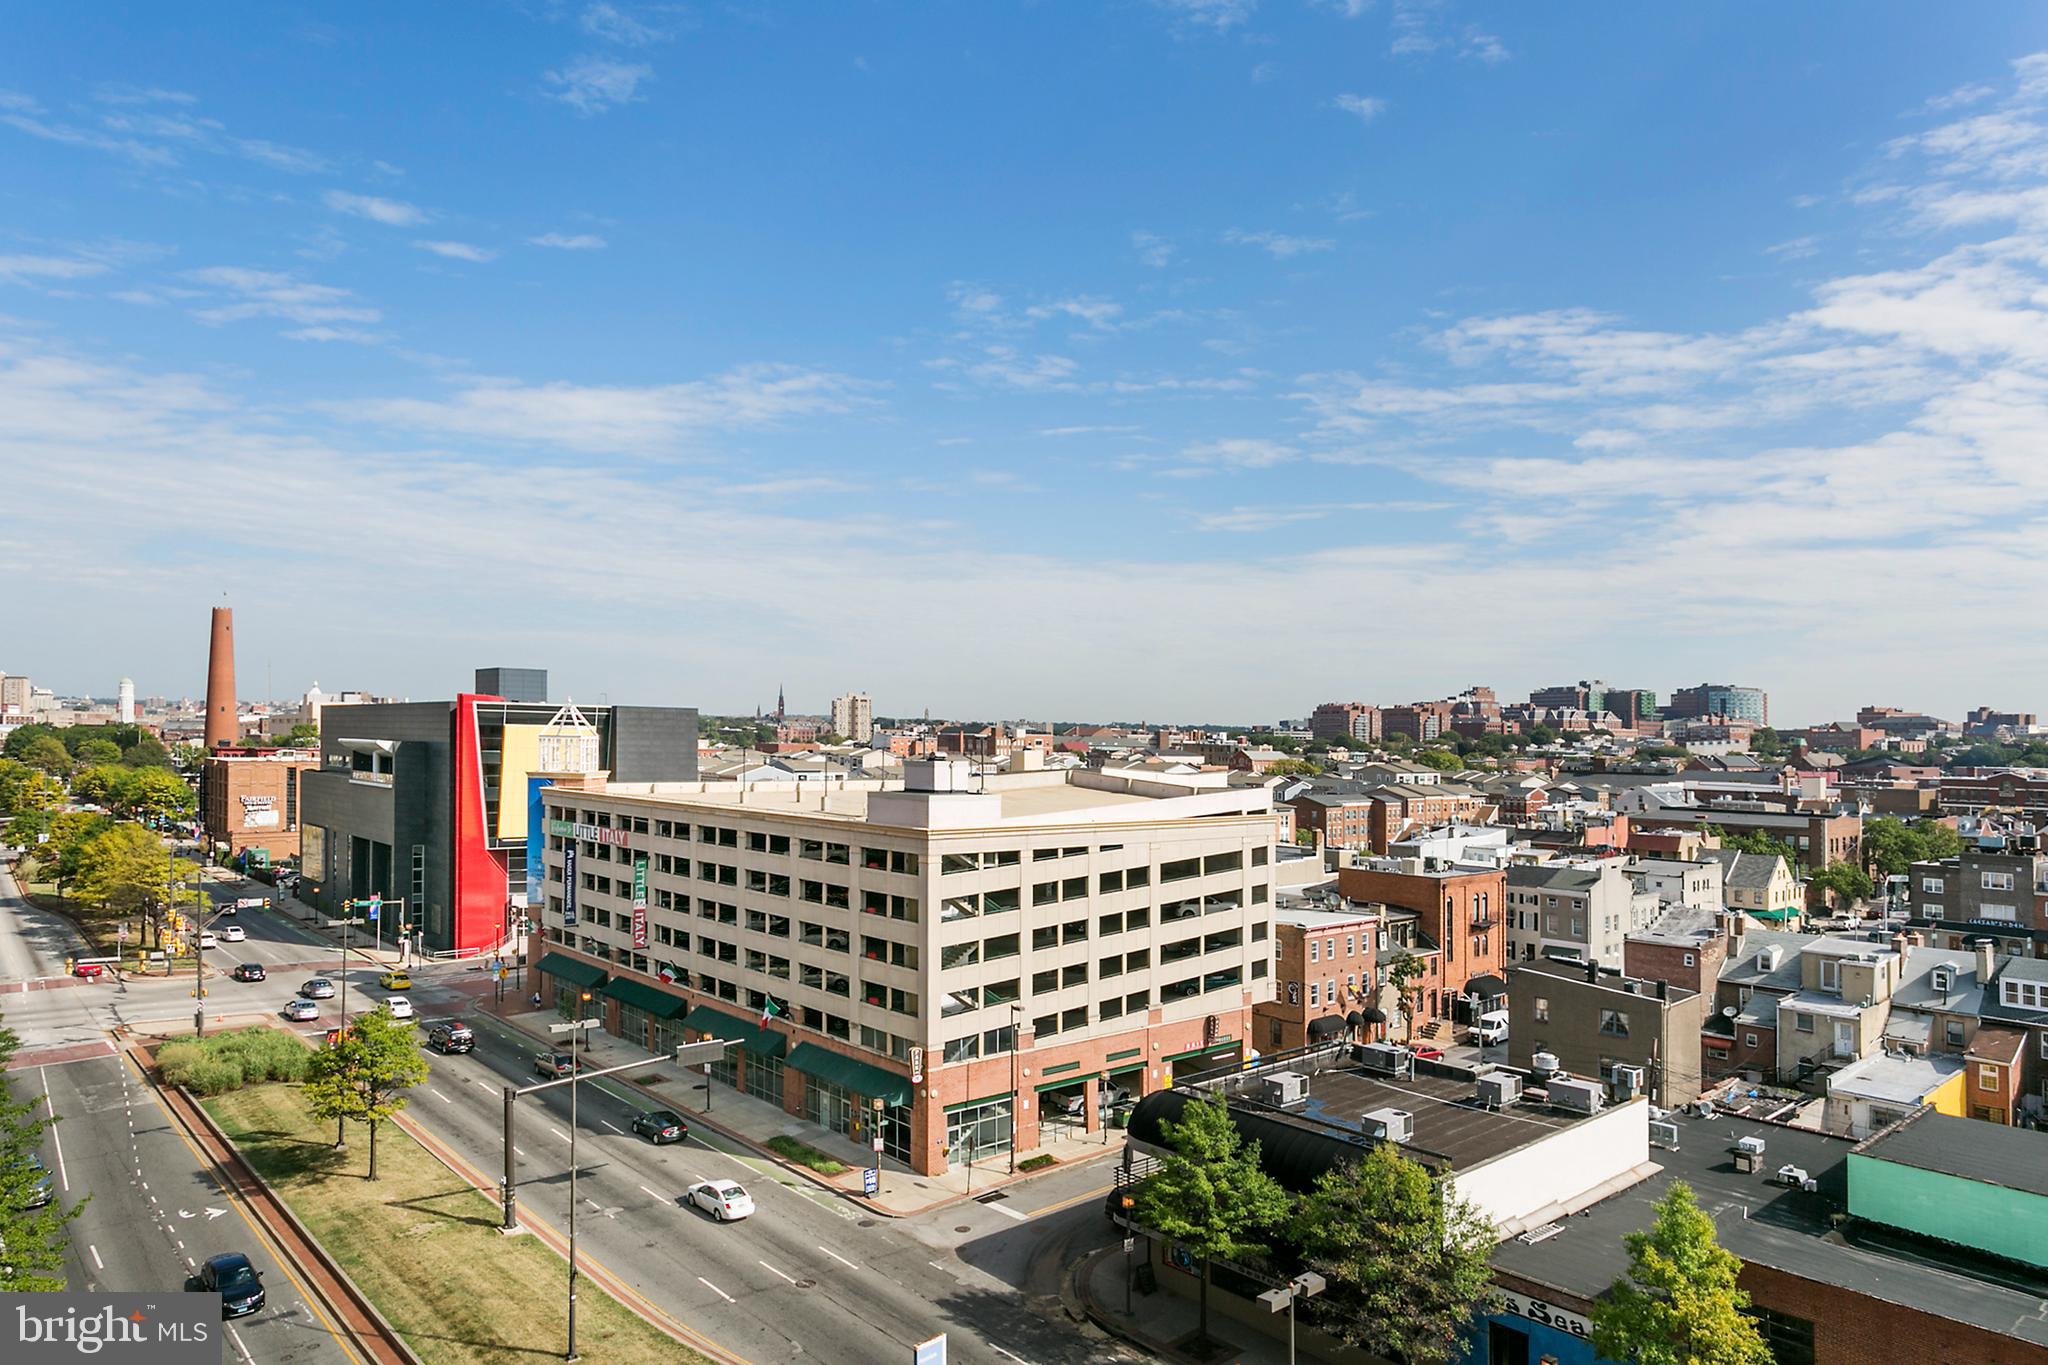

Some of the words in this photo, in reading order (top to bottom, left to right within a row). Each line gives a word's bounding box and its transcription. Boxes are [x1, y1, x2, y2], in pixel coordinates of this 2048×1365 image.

[574, 824, 599, 841] LITTLE
[601, 827, 625, 846] ITALY
[635, 861, 646, 900] LITTLE
[634, 912, 645, 945] ITALY
[1528, 1301, 1590, 1338] Sea
